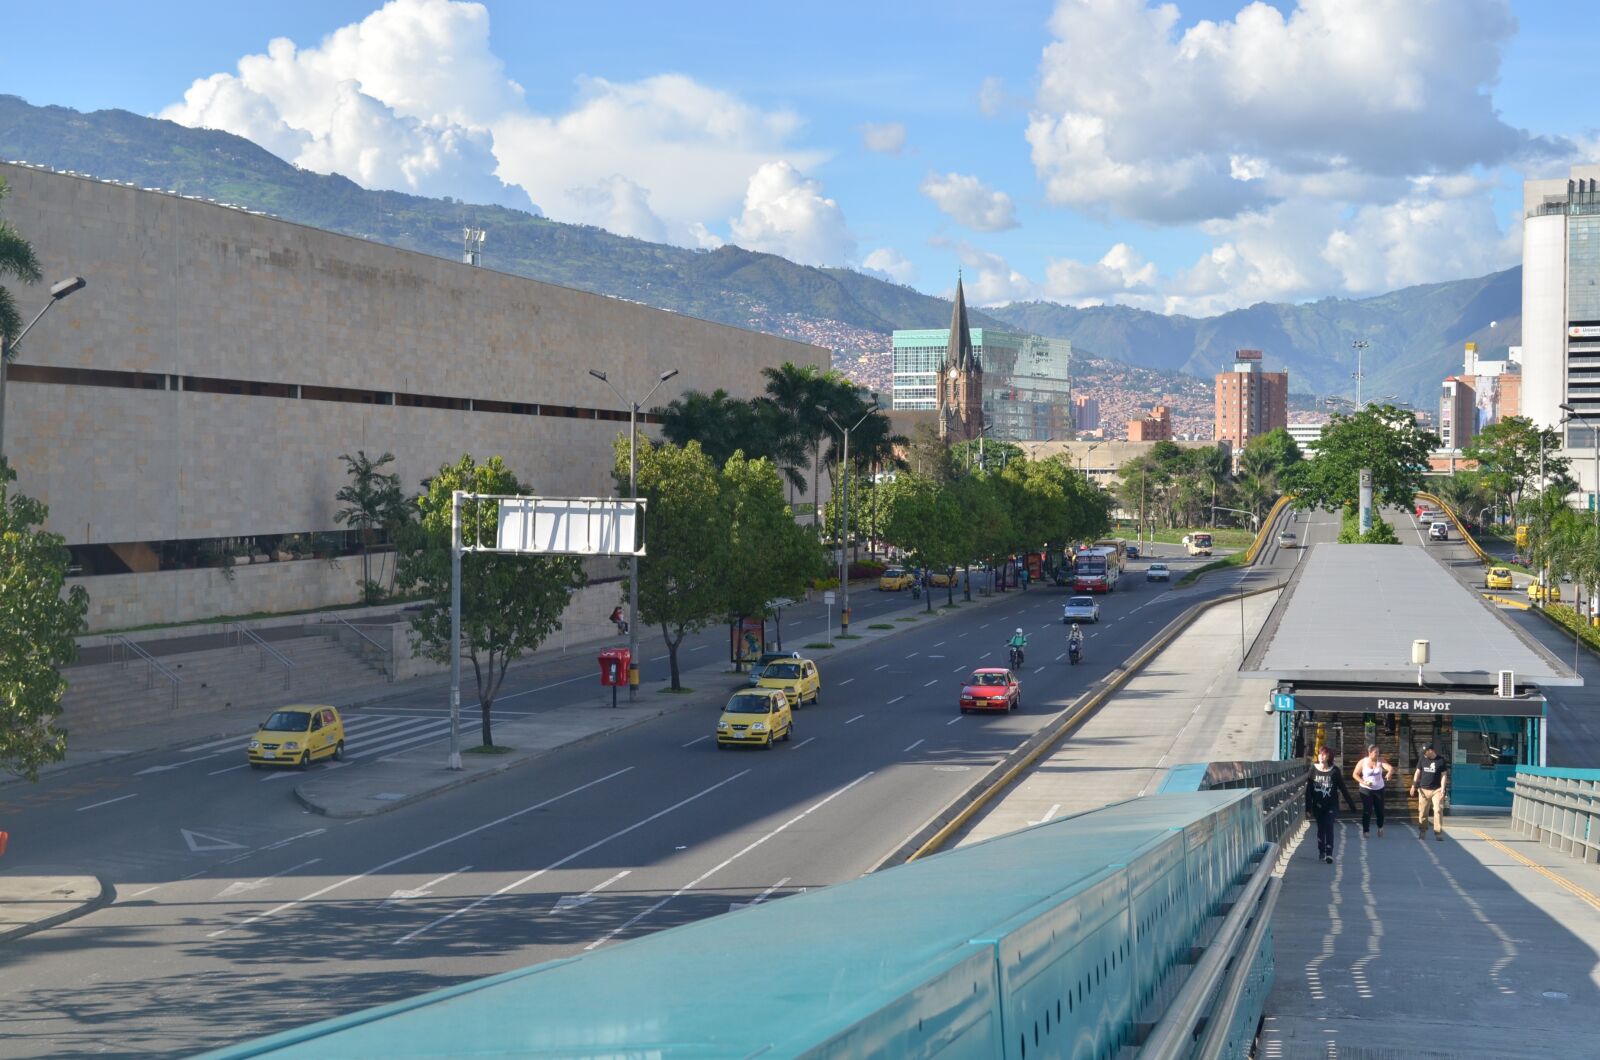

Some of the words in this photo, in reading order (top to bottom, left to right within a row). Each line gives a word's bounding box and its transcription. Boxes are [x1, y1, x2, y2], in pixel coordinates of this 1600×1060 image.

[1278, 694, 1291, 708] L1
[1377, 698, 1409, 710] Plaza
[1413, 699, 1452, 713] Mayor
